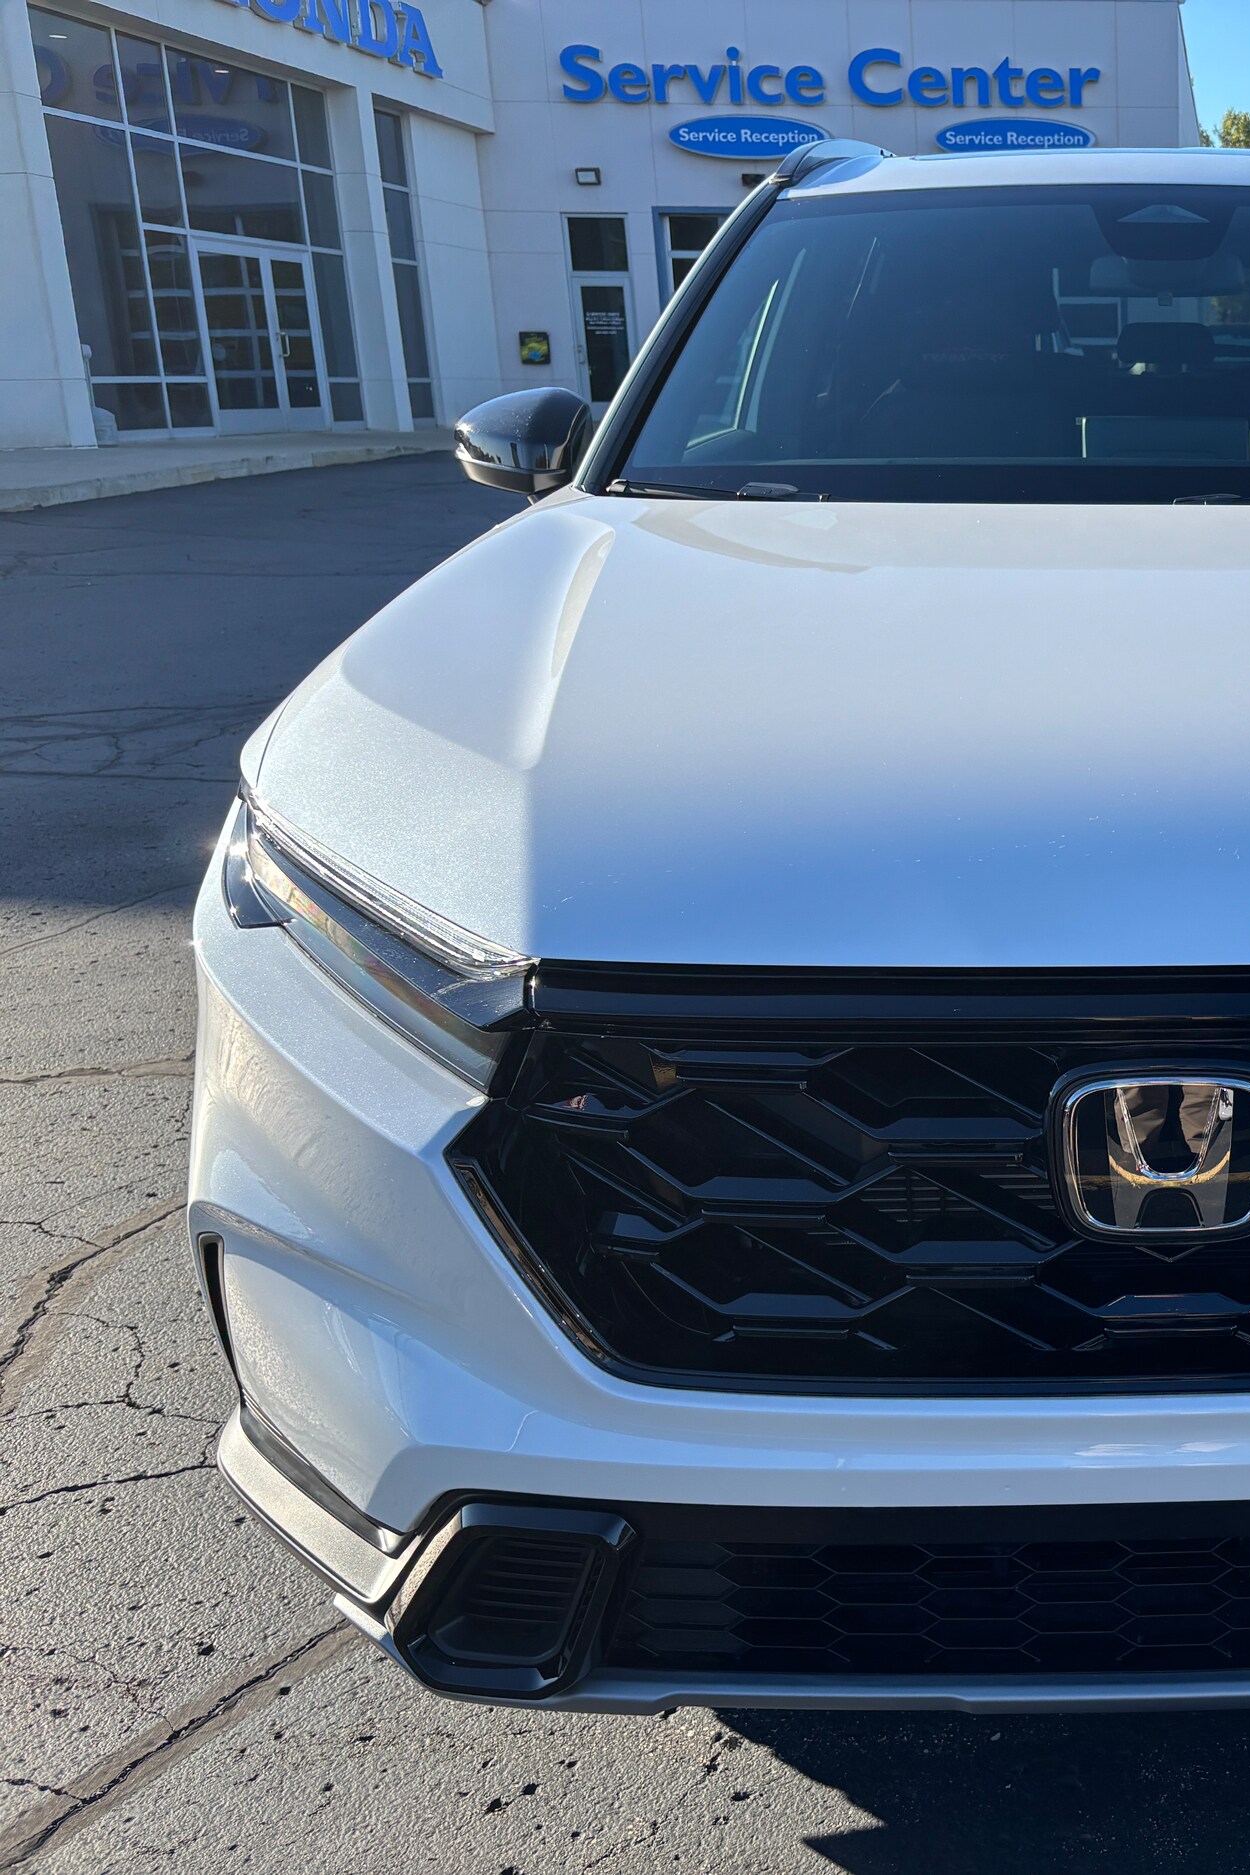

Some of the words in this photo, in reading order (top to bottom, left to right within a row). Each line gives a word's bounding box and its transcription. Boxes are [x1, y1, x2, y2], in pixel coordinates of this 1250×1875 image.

[215, 0, 444, 79] NDA
[559, 44, 826, 105] Service
[848, 47, 1101, 107] Center
[679, 128, 737, 142] Service
[741, 129, 818, 146] Reception
[945, 131, 1003, 145] Service
[1007, 131, 1084, 148] Reception
